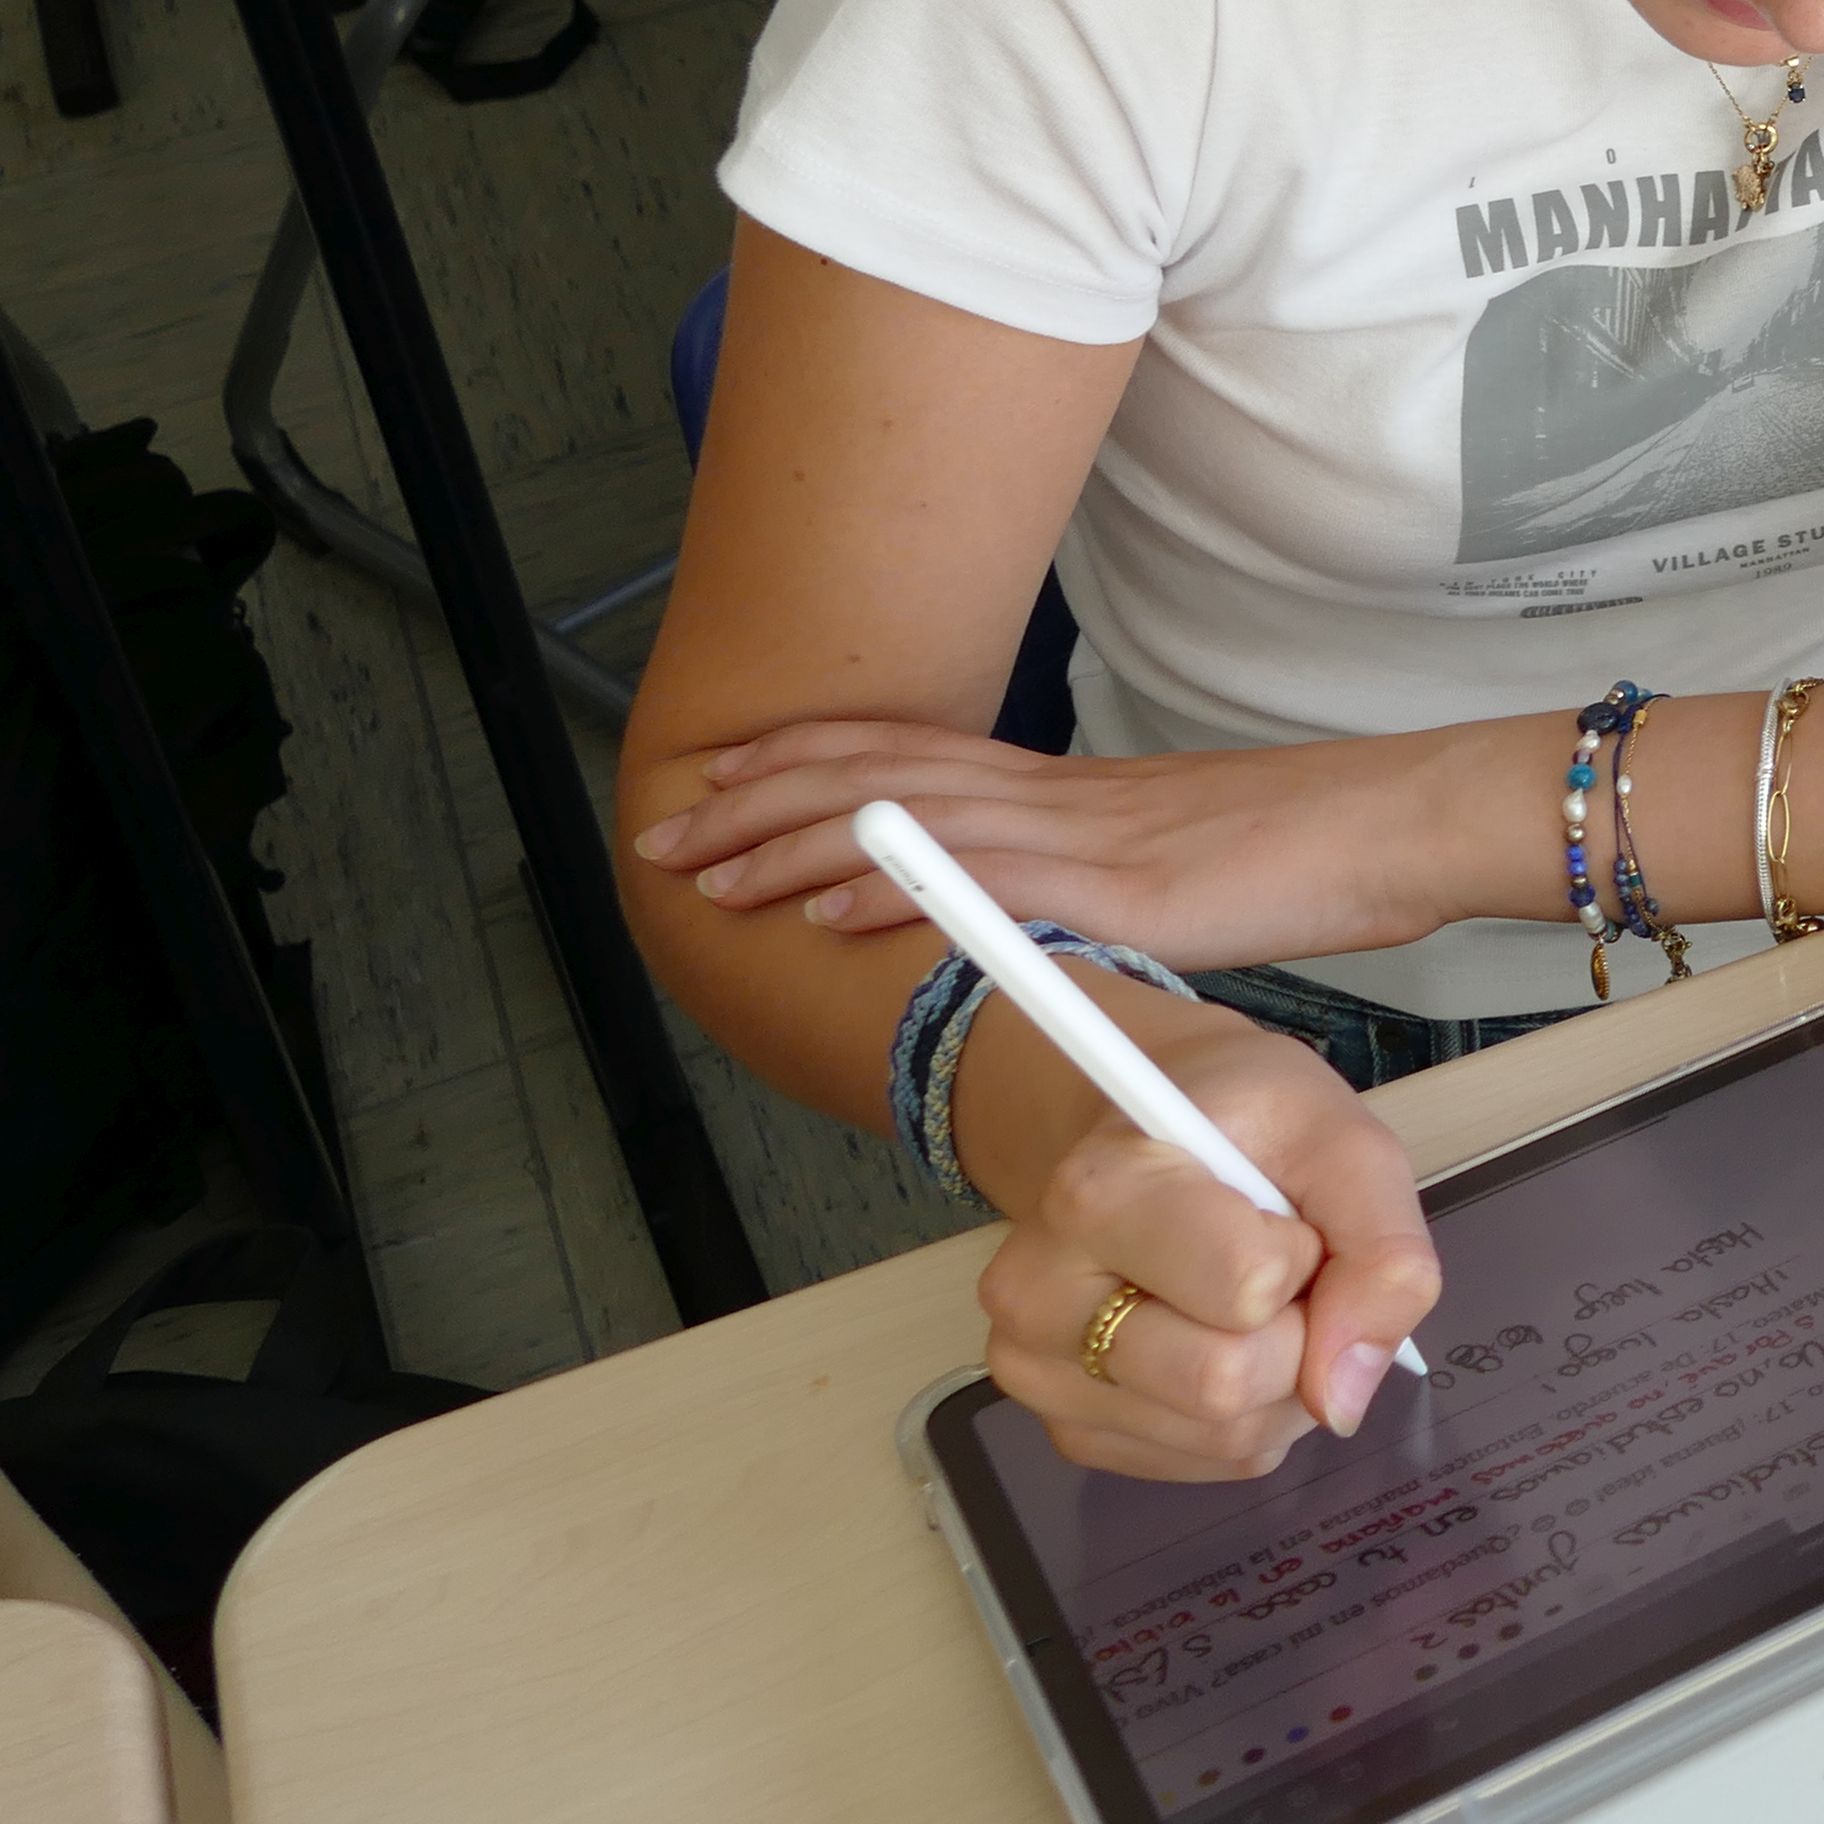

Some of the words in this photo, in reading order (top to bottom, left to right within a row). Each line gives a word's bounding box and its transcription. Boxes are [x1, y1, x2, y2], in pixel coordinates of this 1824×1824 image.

[1652, 537, 1768, 575] VILLAGE
[1739, 546, 1811, 569] MANHATTAN
[1662, 1223, 1762, 1272] Hasta
[1574, 1279, 1661, 1336] luego
[1660, 1352, 1697, 1372] De
[1551, 1371, 1651, 1420] acuerdo.
[1429, 1423, 1542, 1481] Entonces
[1490, 1397, 1702, 1501] estudiamos
[1597, 1465, 1655, 1502] idea!
[1320, 1479, 1420, 1530] mañana
[1419, 1506, 1477, 1536] en
[1249, 1547, 1275, 1564] la
[1279, 1529, 1313, 1550] en
[1357, 1539, 1407, 1566] tu
[1373, 1525, 1519, 1606] ¿Quedamos
[1238, 1572, 1336, 1619] casa
[1329, 1604, 1365, 1625] en
[1289, 1622, 1323, 1648] mi
[1212, 1643, 1282, 1687] casa?
